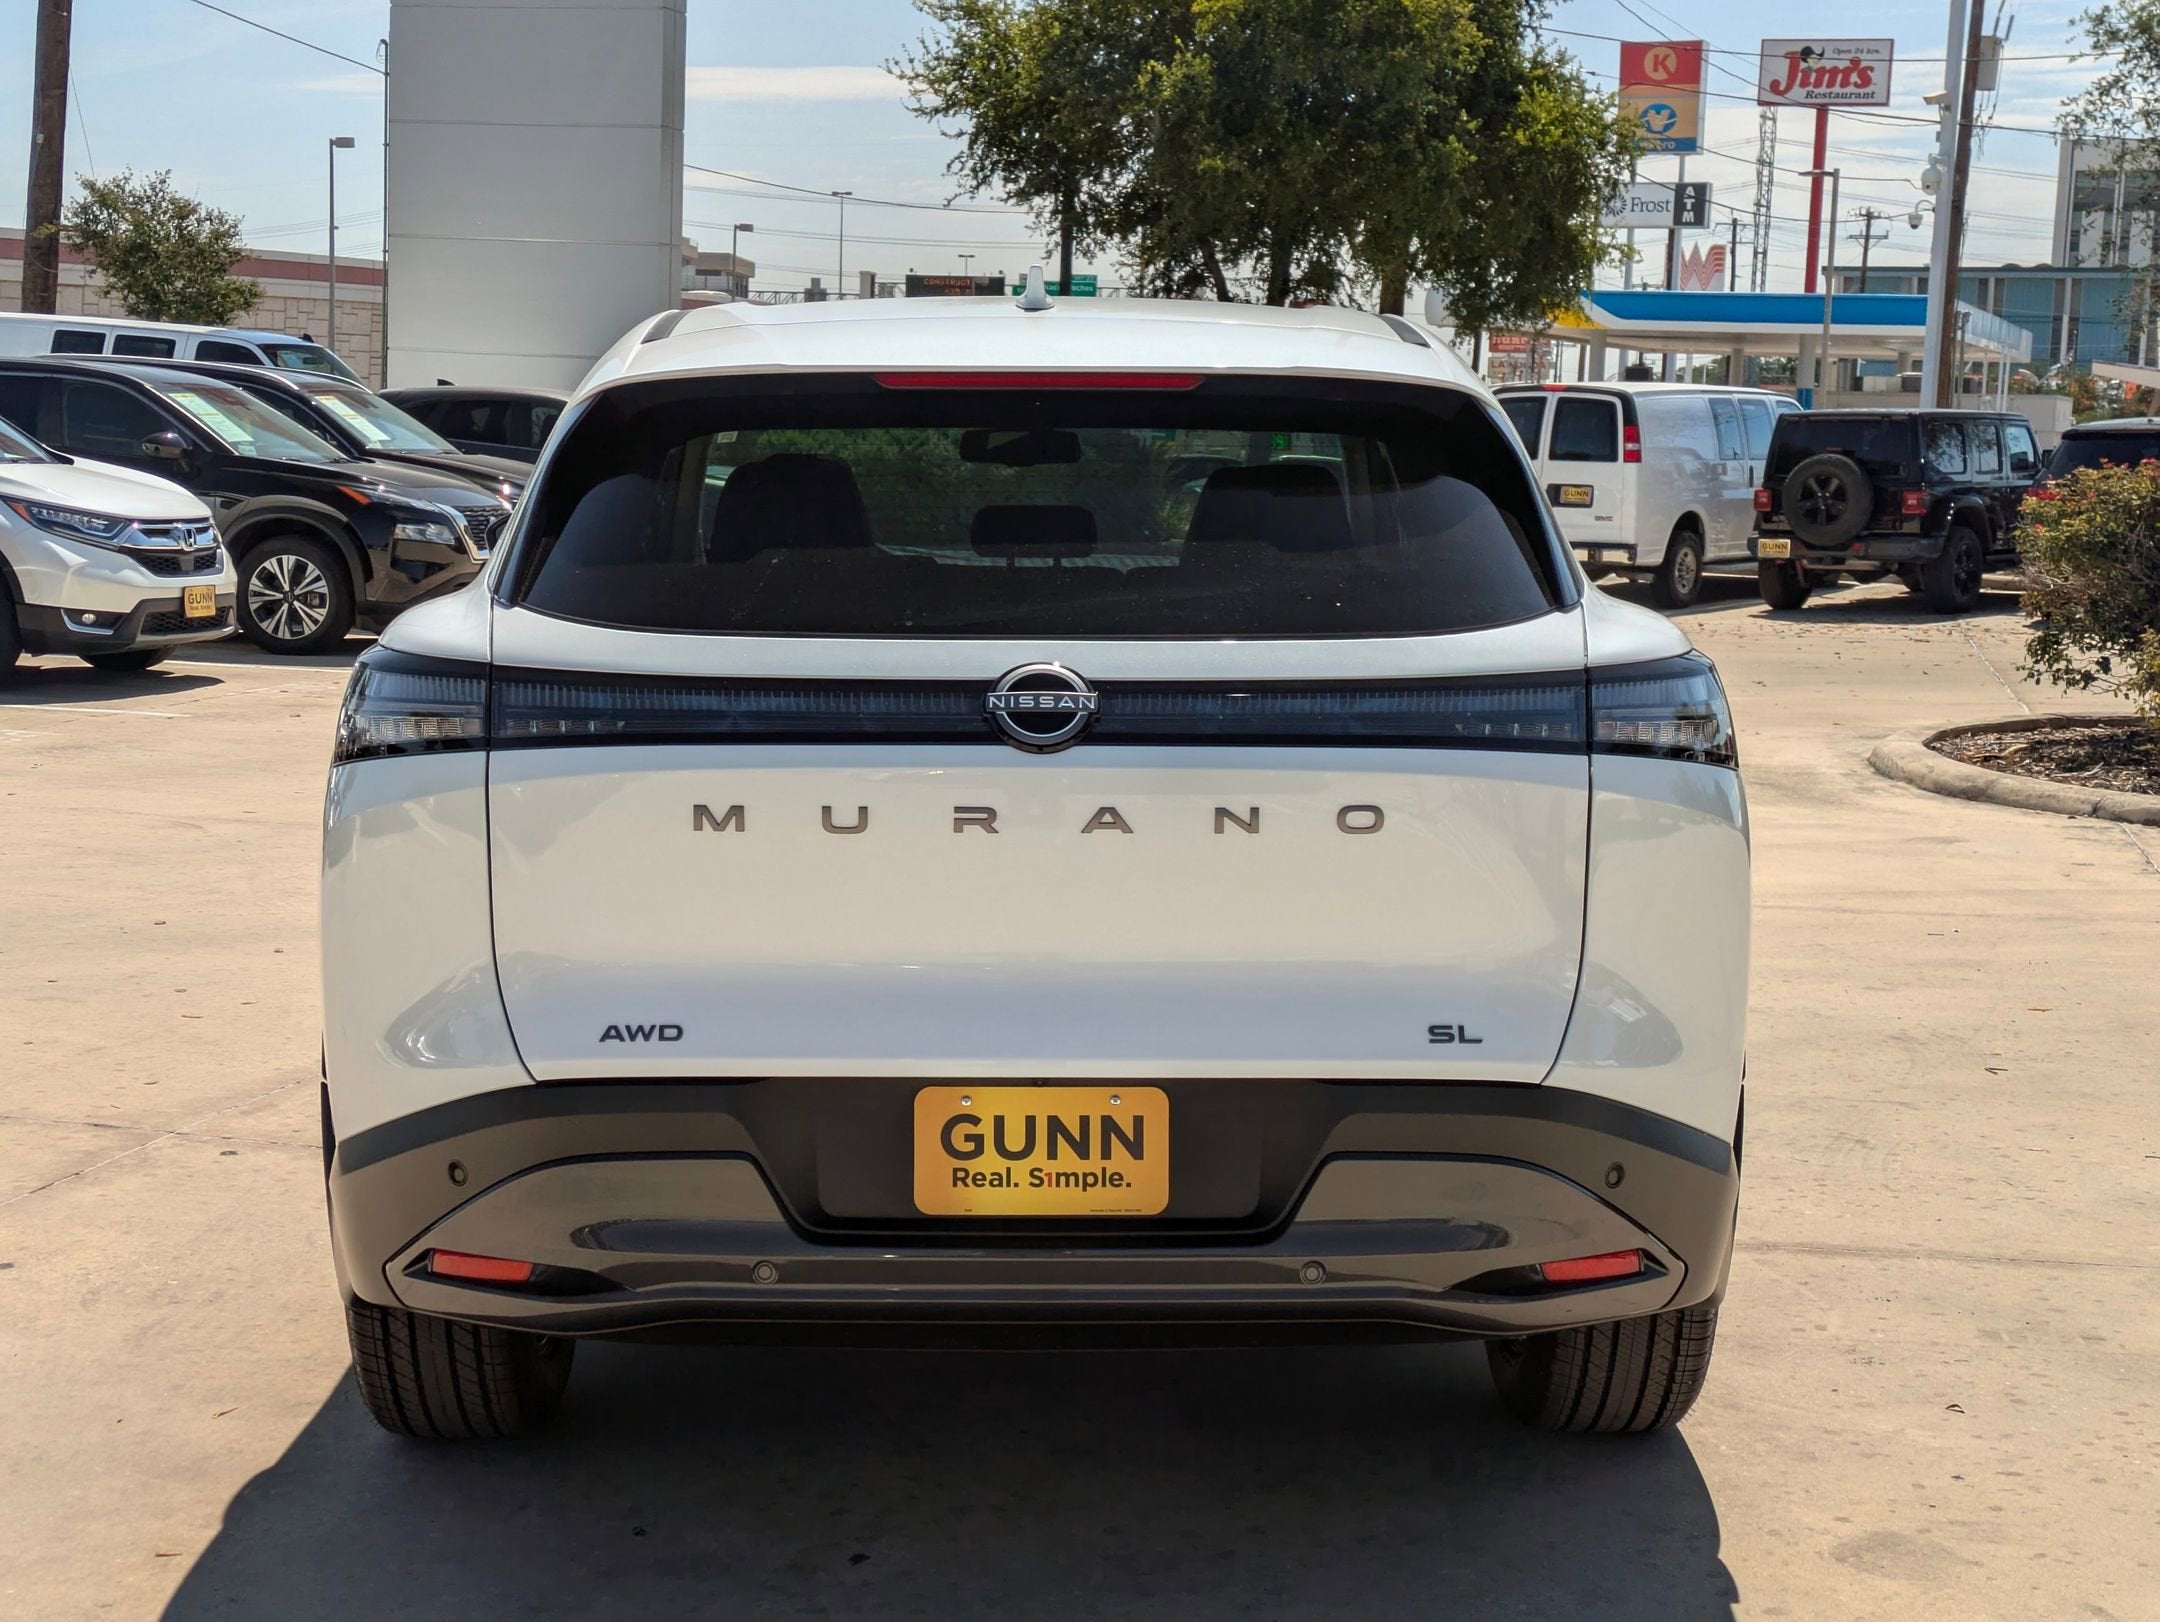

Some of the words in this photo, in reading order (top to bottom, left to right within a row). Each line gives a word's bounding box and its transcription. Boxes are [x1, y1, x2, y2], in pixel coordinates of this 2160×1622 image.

[1832, 47, 1852, 56] Open
[1769, 51, 1875, 97] Jim's
[1804, 89, 1876, 100] Restaurant
[1629, 197, 1672, 213] Frost
[1682, 186, 1696, 223] ATM
[1564, 489, 1589, 497] GUNN
[188, 592, 213, 605] GUNN
[989, 696, 1095, 709] NISSAN
[693, 804, 1386, 835] MURANO
[598, 1024, 684, 1043] AWD
[1427, 1024, 1484, 1045] SL
[940, 1113, 1145, 1162] GUNN
[951, 1167, 1019, 1188] Real.
